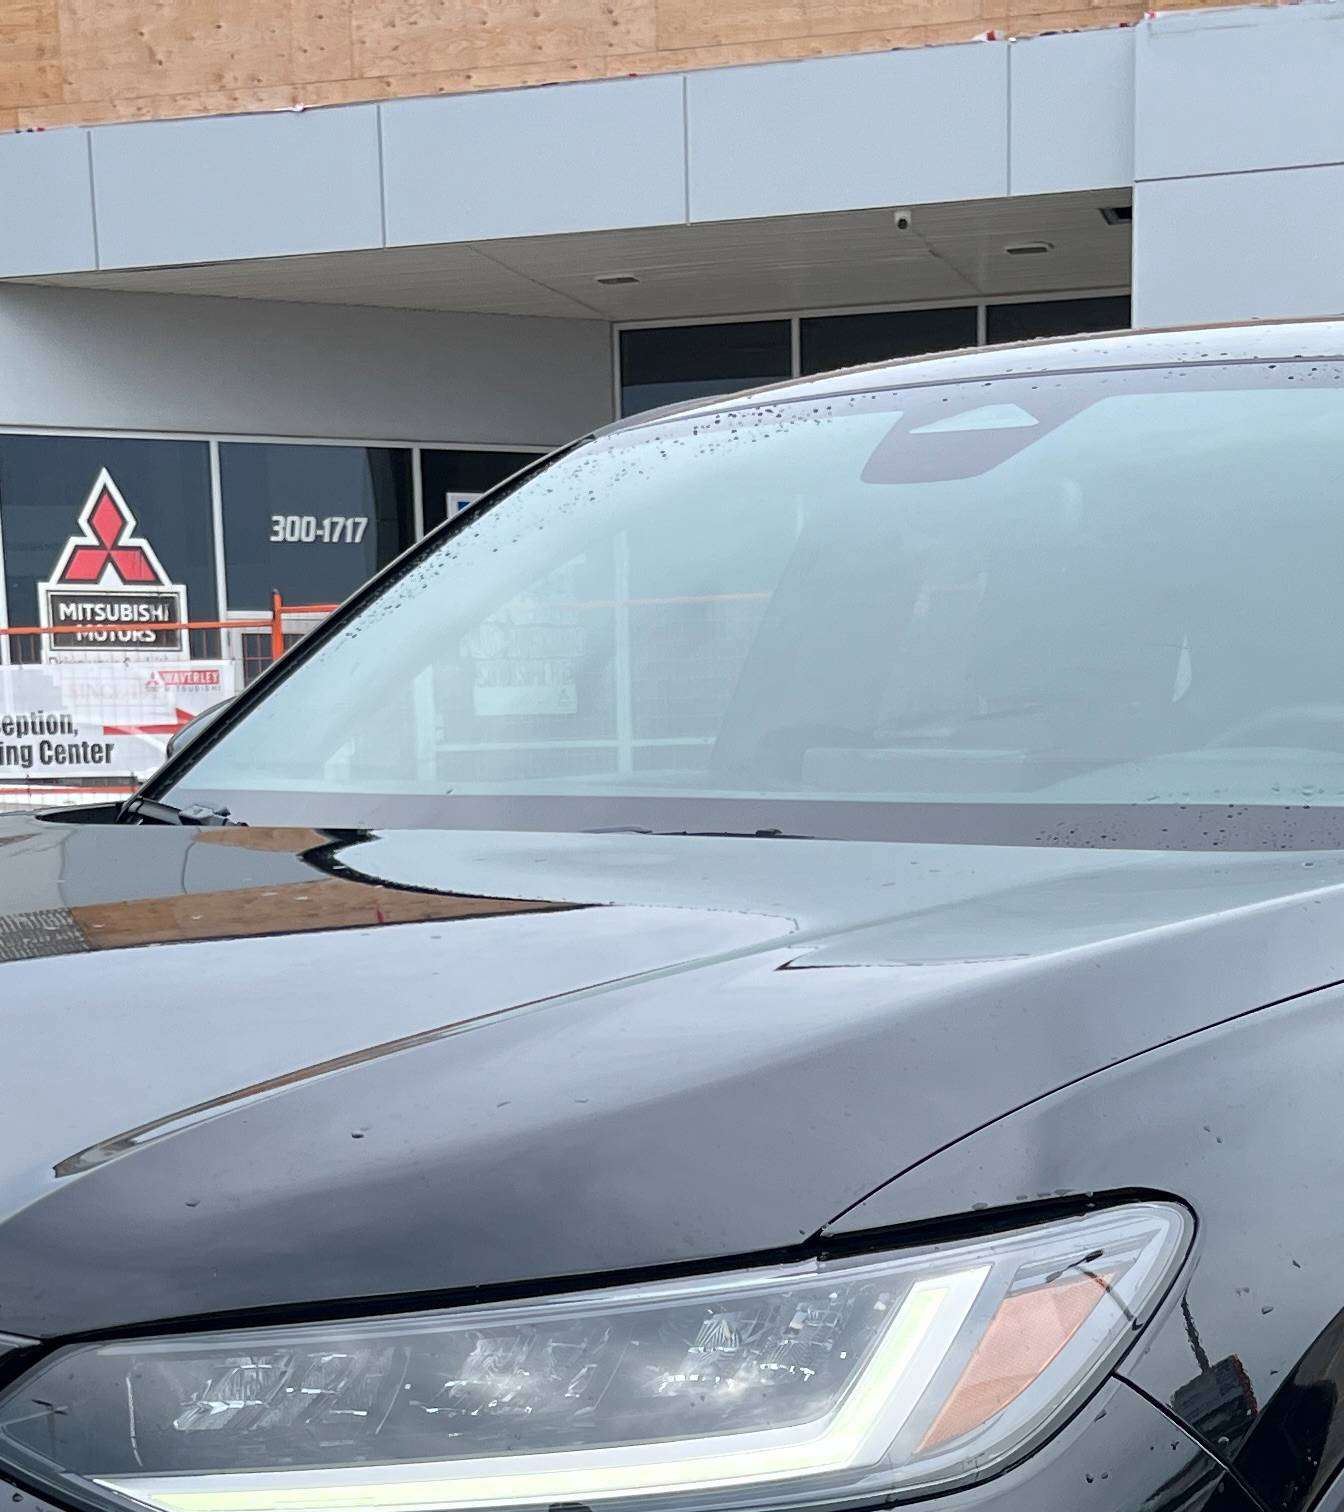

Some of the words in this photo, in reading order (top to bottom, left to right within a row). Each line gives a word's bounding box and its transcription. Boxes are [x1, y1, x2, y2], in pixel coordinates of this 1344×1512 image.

[270, 515, 368, 542] 300-1717
[59, 602, 170, 622] MITSUBISHI
[162, 671, 219, 684] WAVERLEY
[40, 740, 115, 765] Center
